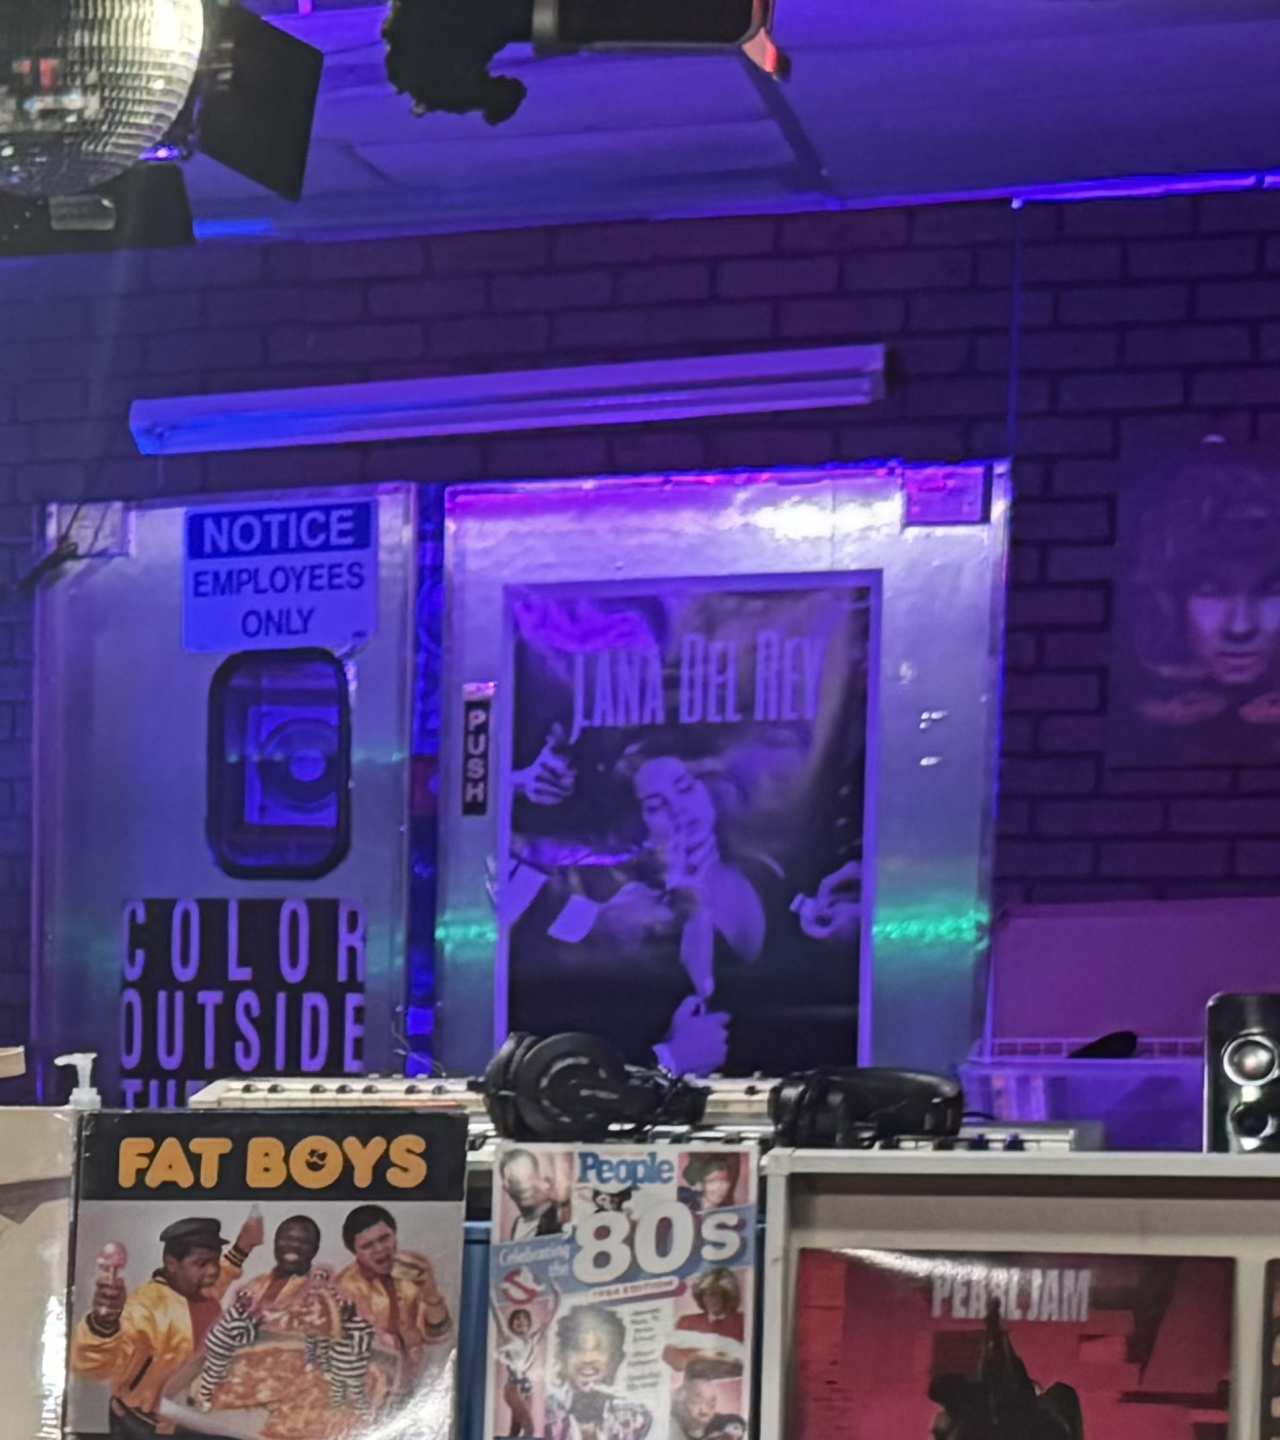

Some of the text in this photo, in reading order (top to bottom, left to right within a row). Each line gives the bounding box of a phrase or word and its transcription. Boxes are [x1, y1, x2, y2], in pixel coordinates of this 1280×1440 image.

[202, 510, 356, 551] NOTICE
[193, 561, 364, 597] EMPLOYEES
[241, 609, 312, 638] ONLY
[575, 632, 824, 732] LANA DEL REY
[468, 709, 483, 804] PUSH
[123, 899, 366, 983] COLOR
[123, 991, 366, 1072] OUTSIDE
[118, 1135, 427, 1190] FAT BOYS
[579, 1151, 674, 1190] People
[573, 1200, 740, 1284] 80s
[932, 1269, 1092, 1322] PEARL JAM
